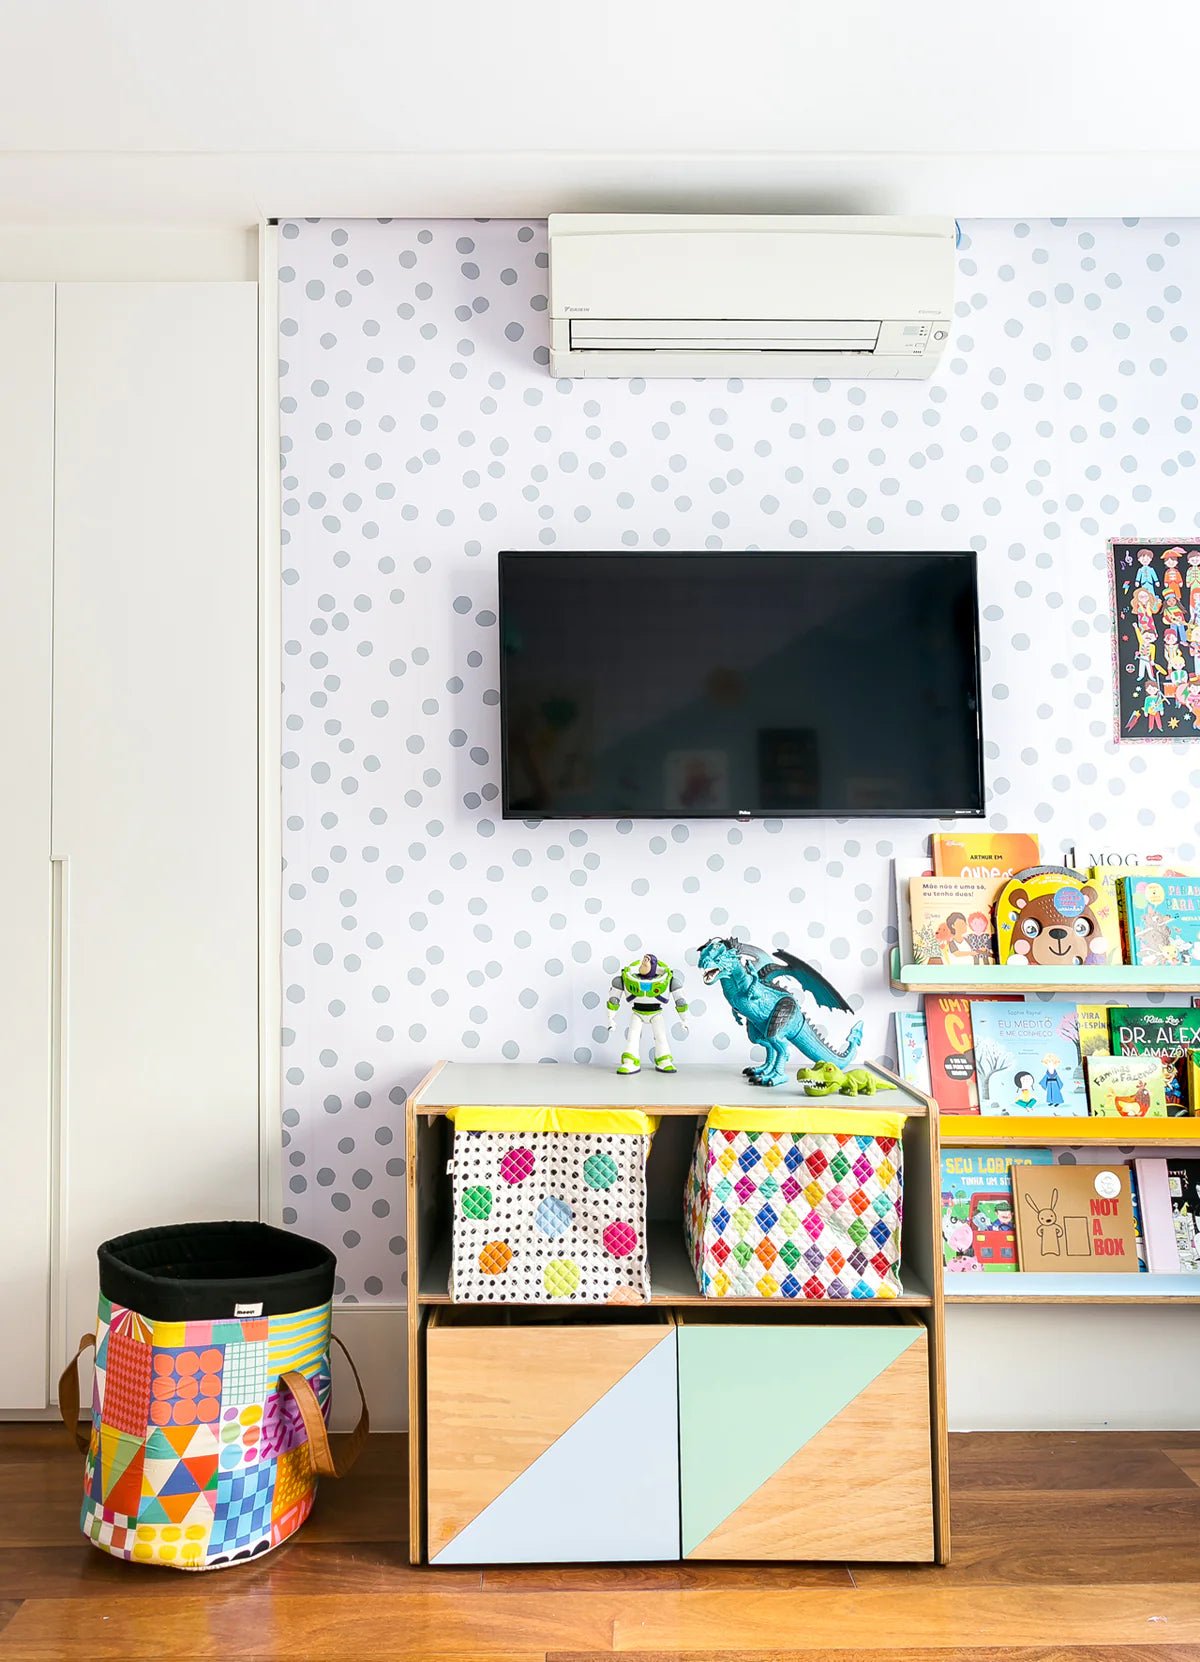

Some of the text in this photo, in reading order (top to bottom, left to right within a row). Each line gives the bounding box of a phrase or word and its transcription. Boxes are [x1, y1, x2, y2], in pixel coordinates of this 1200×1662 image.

[1089, 853, 1139, 867] MOG
[998, 1020, 1012, 1029] EU
[1143, 1015, 1180, 1026] Rita Lee
[1120, 1027, 1200, 1044] DR. ALEX
[1122, 1047, 1138, 1057] NA
[946, 1157, 973, 1174] SEU
[961, 1176, 984, 1185] TINHA
[986, 1177, 998, 1185] UM
[1090, 1198, 1119, 1216] NOT
[1093, 1219, 1103, 1235] A
[1094, 1238, 1125, 1255] BOX
